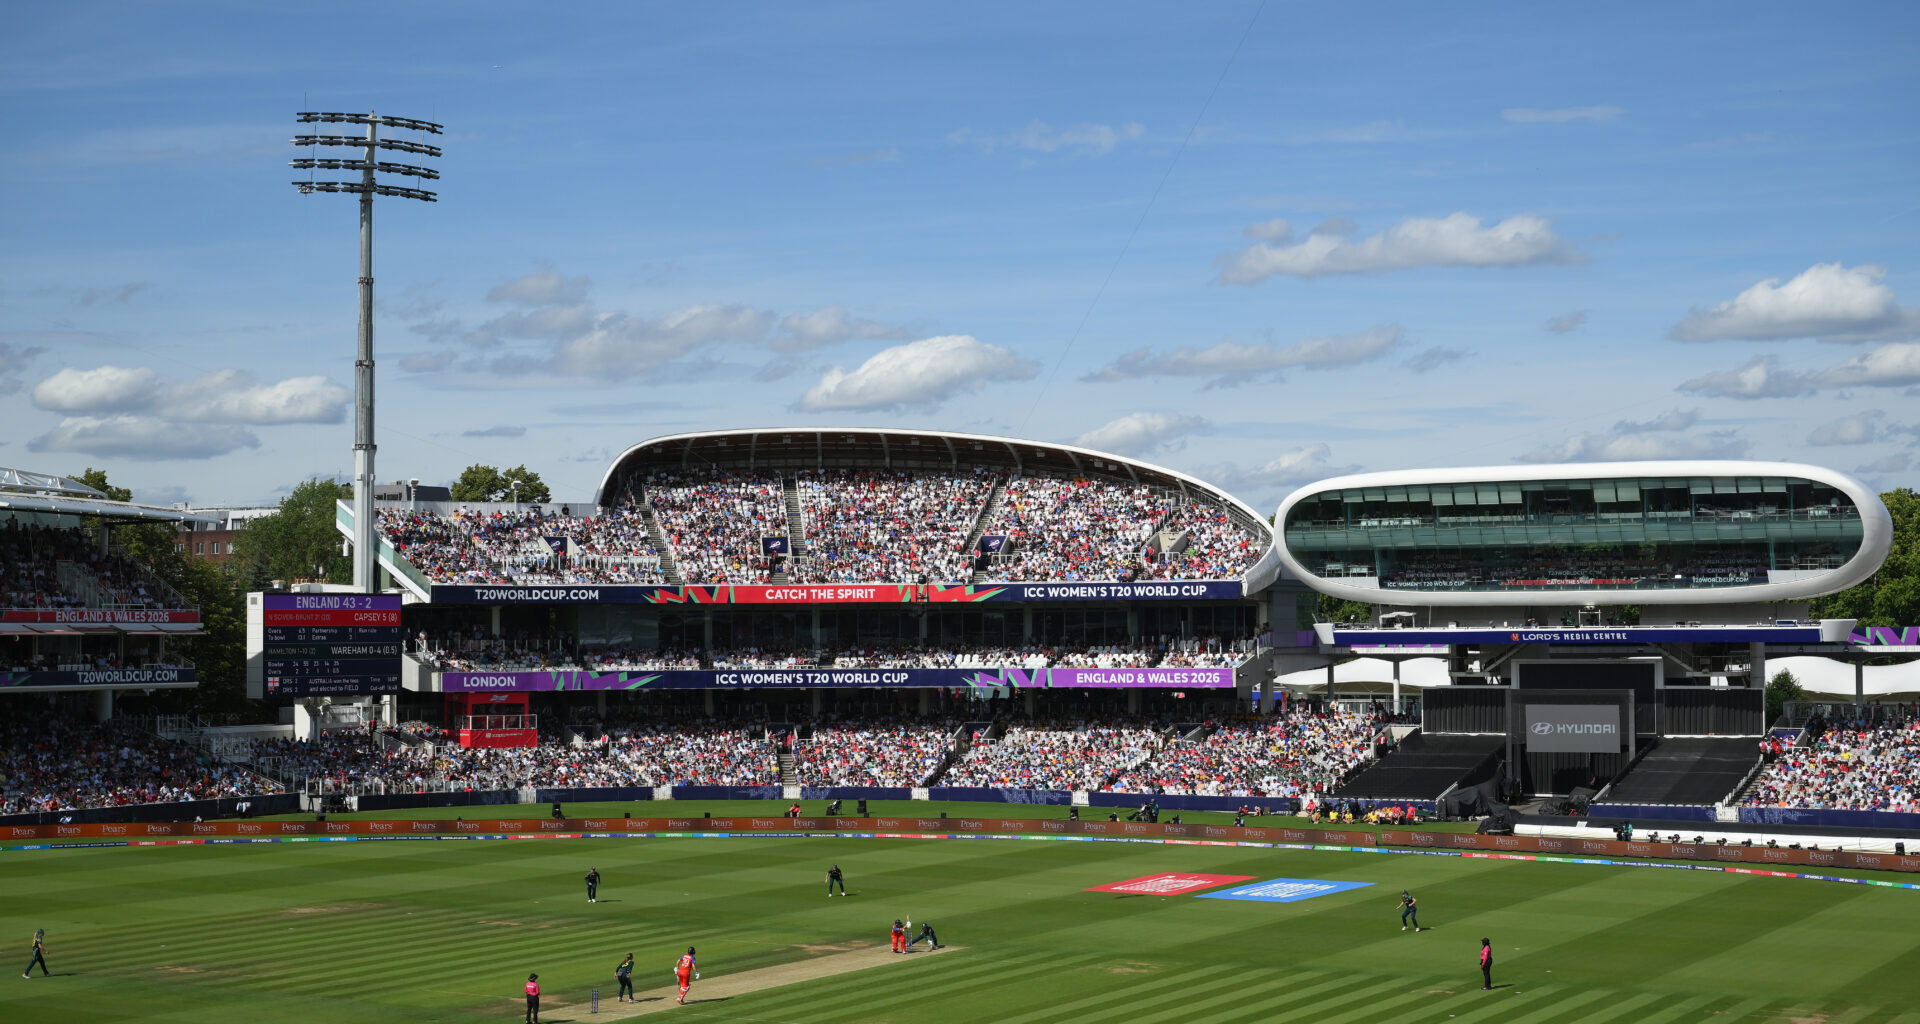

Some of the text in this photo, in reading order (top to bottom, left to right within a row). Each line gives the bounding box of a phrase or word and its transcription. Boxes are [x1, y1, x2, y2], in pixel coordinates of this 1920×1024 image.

[474, 589, 599, 600] T20WORLDCUP.COM
[765, 588, 876, 600] CATCH THE SPIRIT
[1024, 586, 1207, 598] ICC WOMEN'S T20 WORLD CUP
[296, 596, 340, 608] ENGLAND
[342, 596, 356, 608] 43
[366, 597, 372, 608] 2
[56, 612, 170, 622] ENGLAND & WALES 2026
[354, 612, 398, 622] CAPSEY 5 (8)
[331, 646, 398, 656] WAREHAM 0-4 (0.5)
[77, 670, 178, 684] T20WORLDCUP.COM
[715, 672, 908, 684] ICC WOMEN'S T20 WORLD CUP
[1076, 672, 1220, 684] ENGLAND & WALES 2026
[464, 676, 516, 688] LONDON
[1557, 724, 1616, 734] HYUNDAI
[147, 824, 171, 833] Pears
[193, 824, 217, 832] Pears
[238, 824, 262, 832] Pears
[282, 823, 305, 832] Pears
[327, 822, 350, 830] Pears
[370, 822, 392, 830] Pears
[457, 821, 479, 829] Pears
[626, 820, 649, 828] Pears
[960, 820, 983, 828] Pears
[1002, 821, 1024, 829] Pears
[1125, 824, 1147, 832] Pears
[12, 828, 36, 836] Pears
[57, 826, 81, 834] Pears
[102, 825, 126, 833] Pears
[1206, 826, 1227, 835] Pears
[1245, 828, 1266, 836] Pears
[1284, 830, 1306, 838] Pears
[1325, 832, 1346, 841] Pears
[1411, 833, 1433, 842] Pears
[1454, 835, 1477, 844] Pears
[1496, 837, 1519, 846] Pears
[1538, 839, 1562, 848] Pears
[1583, 841, 1607, 849] Pears
[1627, 843, 1650, 852] Pears
[1671, 845, 1696, 854] Pears
[1718, 847, 1742, 856] Pears
[1763, 850, 1788, 858] Pears
[1809, 852, 1834, 860] Pears
[1856, 854, 1880, 864] Pears
